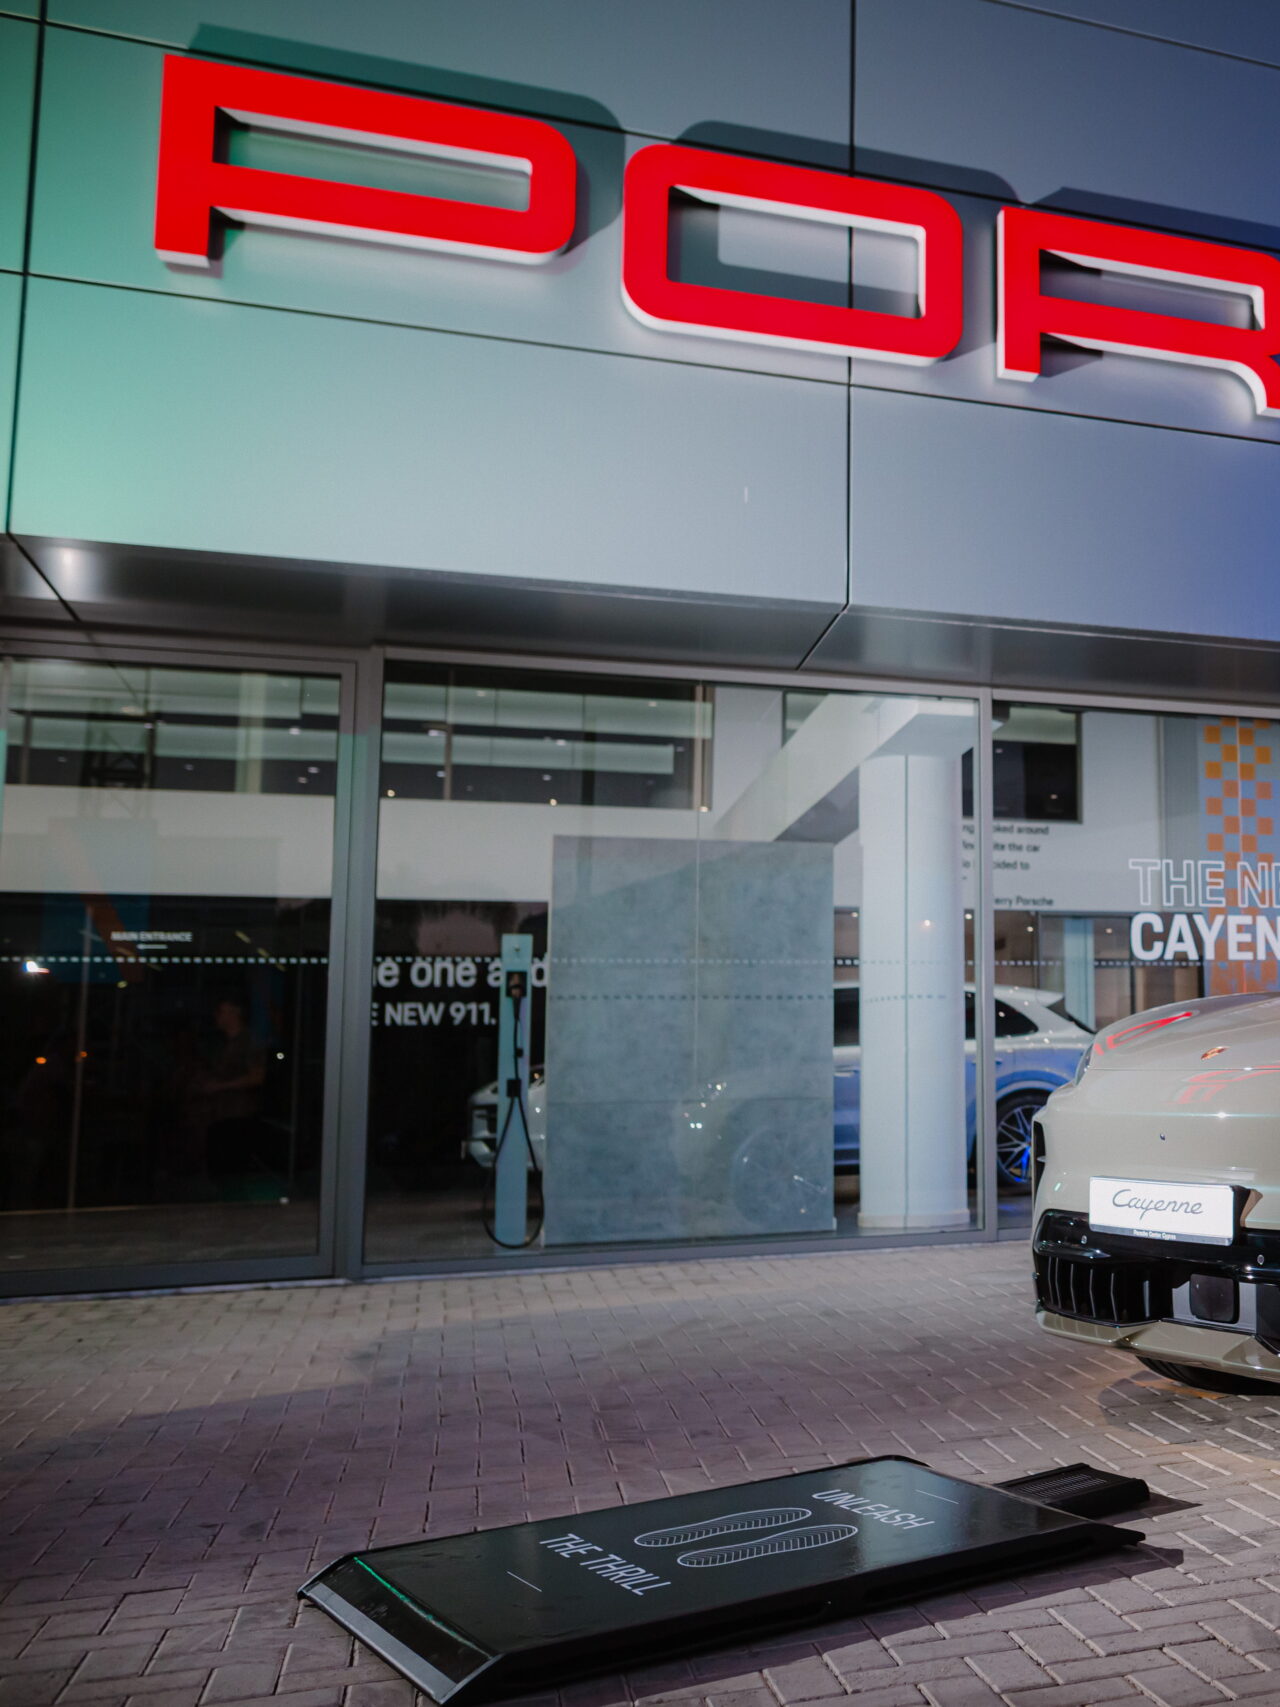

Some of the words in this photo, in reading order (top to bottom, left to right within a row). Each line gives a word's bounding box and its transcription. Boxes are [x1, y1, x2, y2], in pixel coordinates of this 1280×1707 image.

[1017, 825, 1050, 835] around
[1007, 842, 1023, 852] the
[1129, 859, 1226, 907] THE
[994, 897, 1013, 908] erry
[1016, 896, 1054, 907] Porsche
[139, 931, 193, 943] ENTRANCE
[410, 959, 478, 988] one
[384, 1001, 445, 1027] NEW
[449, 1002, 498, 1027] 911.
[1112, 1188, 1205, 1220] Cayenne
[811, 1489, 935, 1530] UNLEASH
[539, 1533, 604, 1558] THE
[579, 1553, 671, 1596] THRILL
